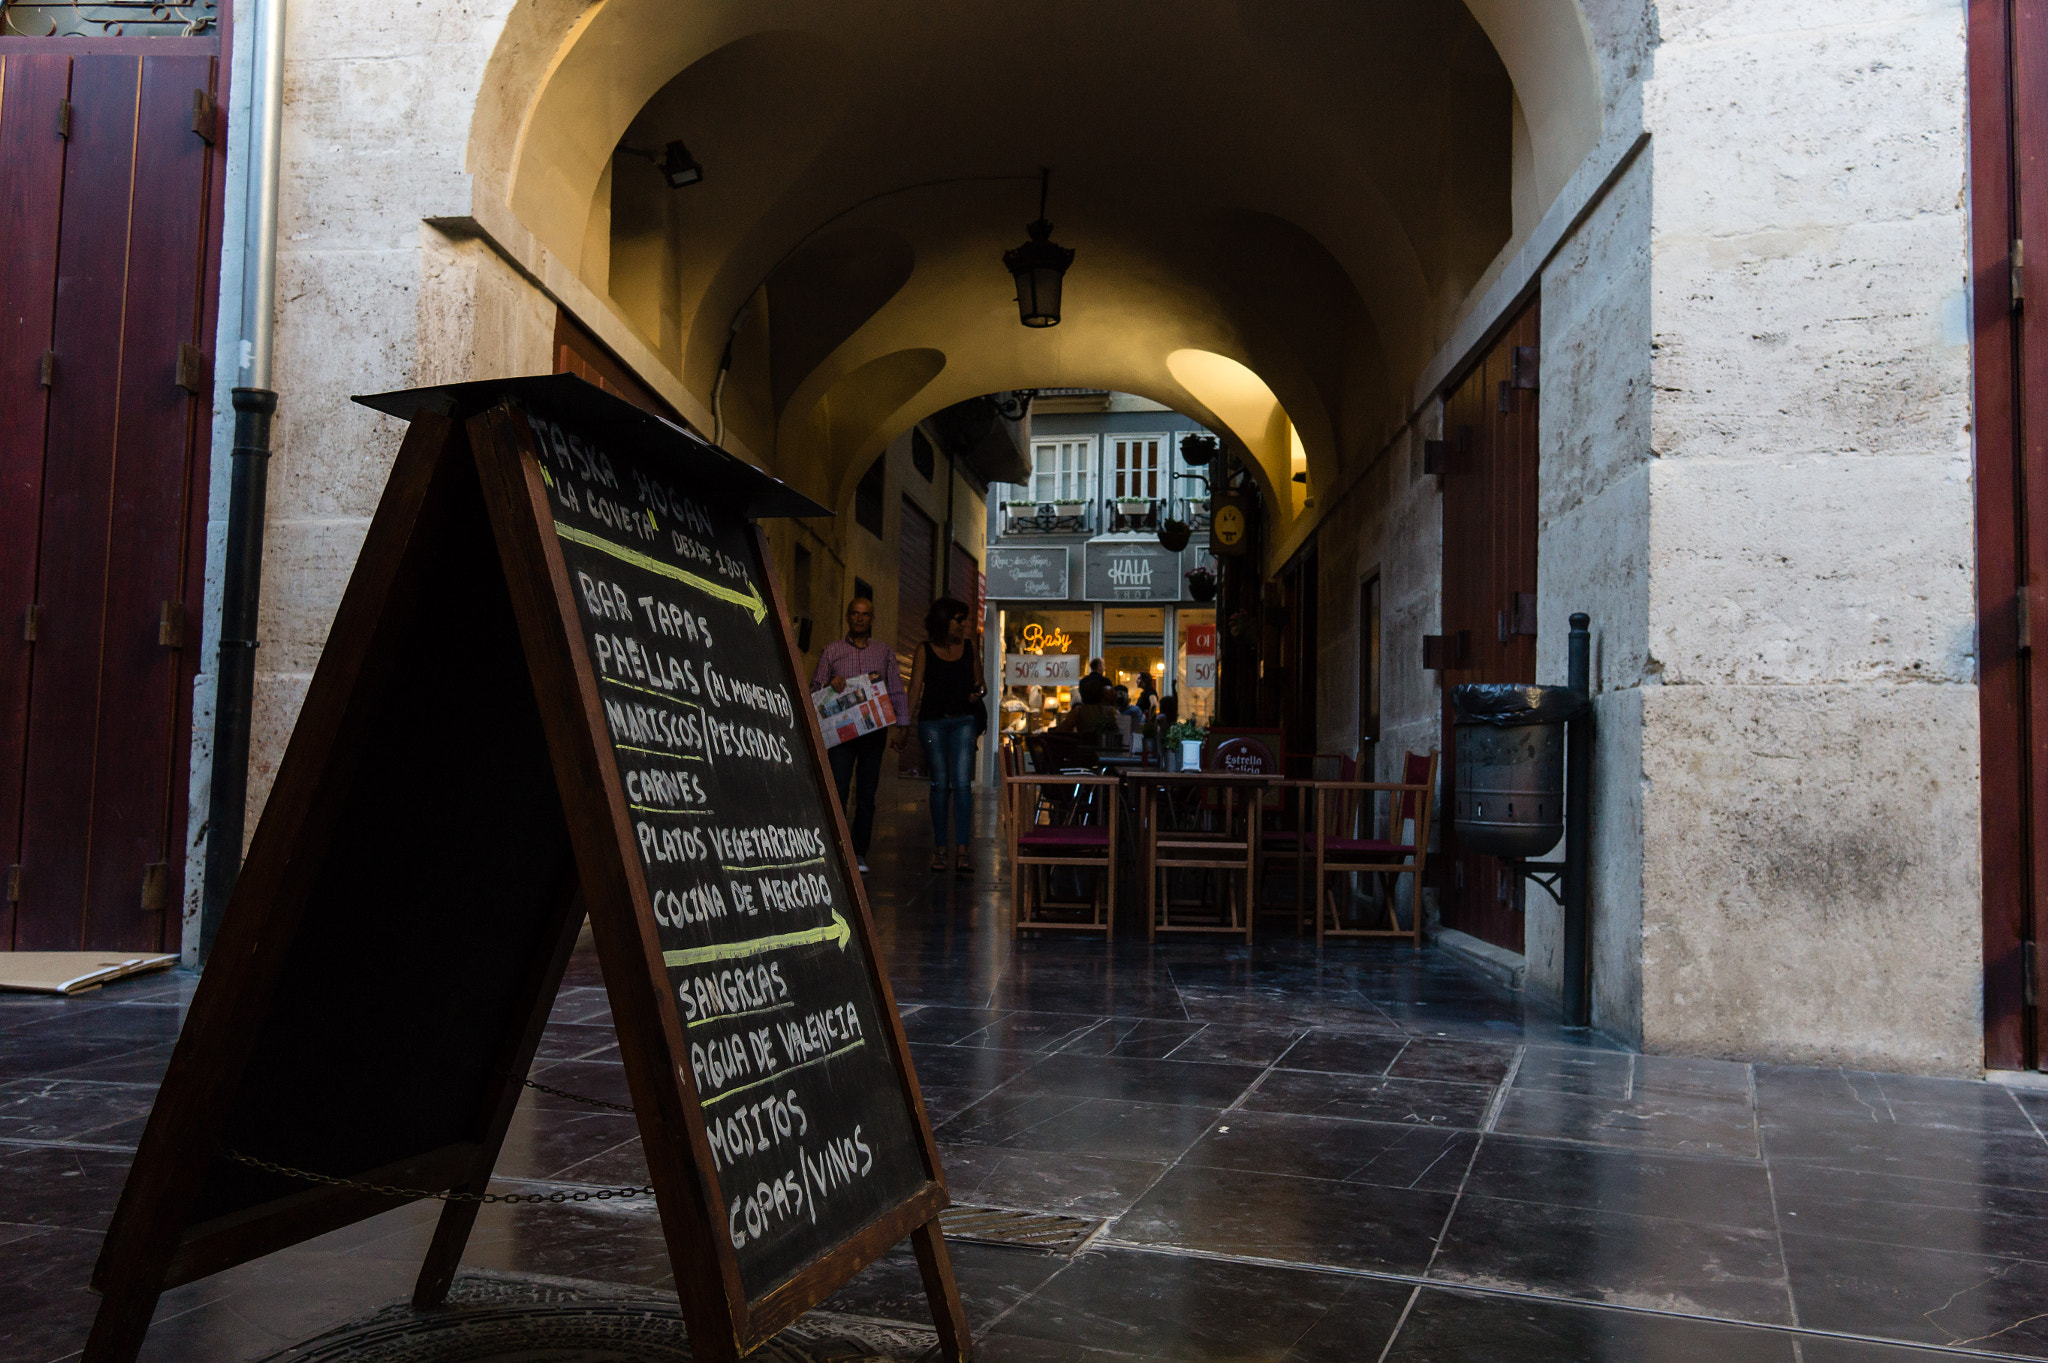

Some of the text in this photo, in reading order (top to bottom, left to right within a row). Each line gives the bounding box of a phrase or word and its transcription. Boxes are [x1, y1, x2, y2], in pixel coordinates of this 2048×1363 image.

[671, 529, 713, 566] DESDE
[1108, 559, 1153, 585] KALA
[577, 570, 714, 650] BAR TAPAS
[1113, 590, 1152, 600] SHOP
[595, 632, 701, 697] PAELLAS
[1015, 660, 1071, 679] 50% 50%
[1225, 754, 1263, 766] Estrella
[625, 768, 708, 805] CARNES
[636, 820, 827, 864] PLATOS VEGETARIANOS
[652, 872, 833, 930] COCINA DE MERCADO
[678, 960, 789, 1021] SANGRIAS
[690, 1000, 863, 1095] AGUA DE VALENCIA
[705, 1088, 809, 1173] MOJITOS
[728, 1123, 874, 1250] COPAS/VINOS
